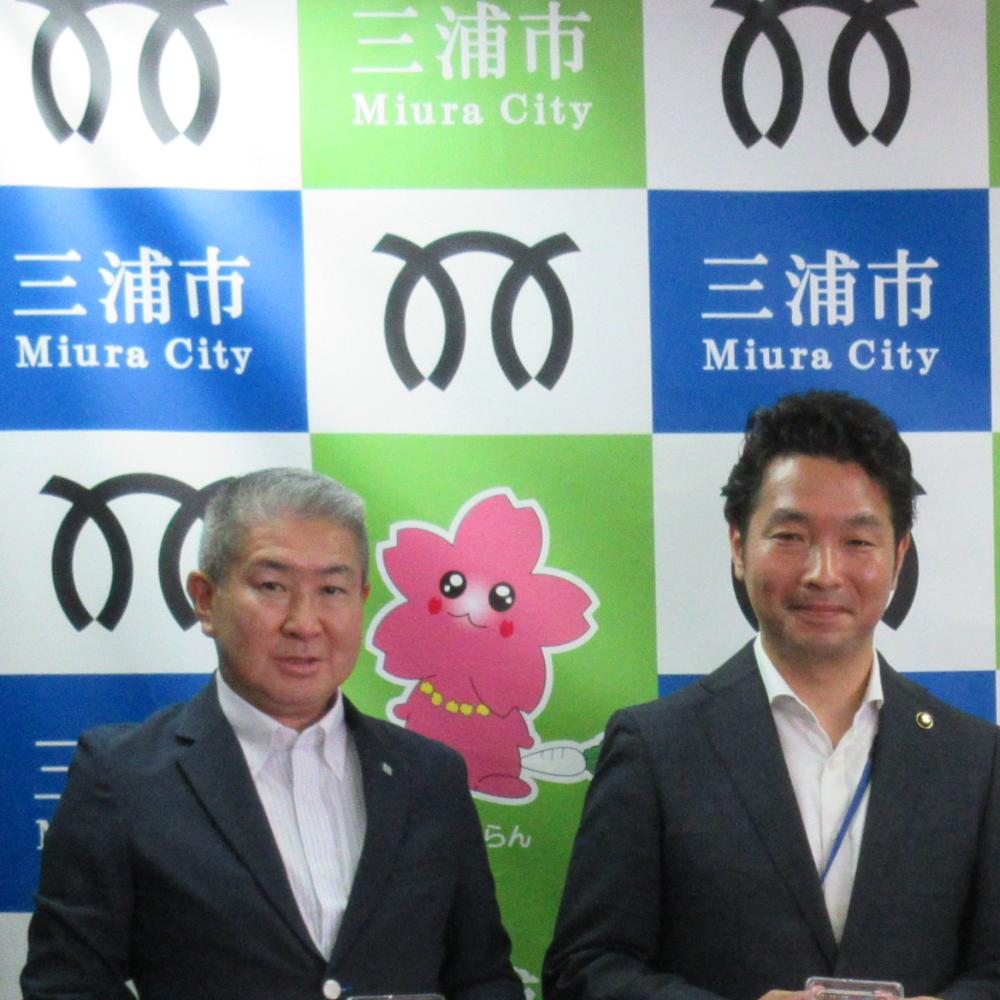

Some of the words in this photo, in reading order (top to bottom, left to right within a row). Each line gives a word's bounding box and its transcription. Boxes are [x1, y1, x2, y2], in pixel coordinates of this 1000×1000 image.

[351, 1, 591, 80] 三浦市
[352, 92, 484, 126] Miura
[500, 92, 593, 130] City
[14, 246, 250, 325] 三浦市
[702, 249, 939, 327] 三浦市
[16, 335, 149, 368] Miura
[164, 338, 253, 374] City
[702, 338, 832, 371] Miura
[848, 338, 940, 375] City
